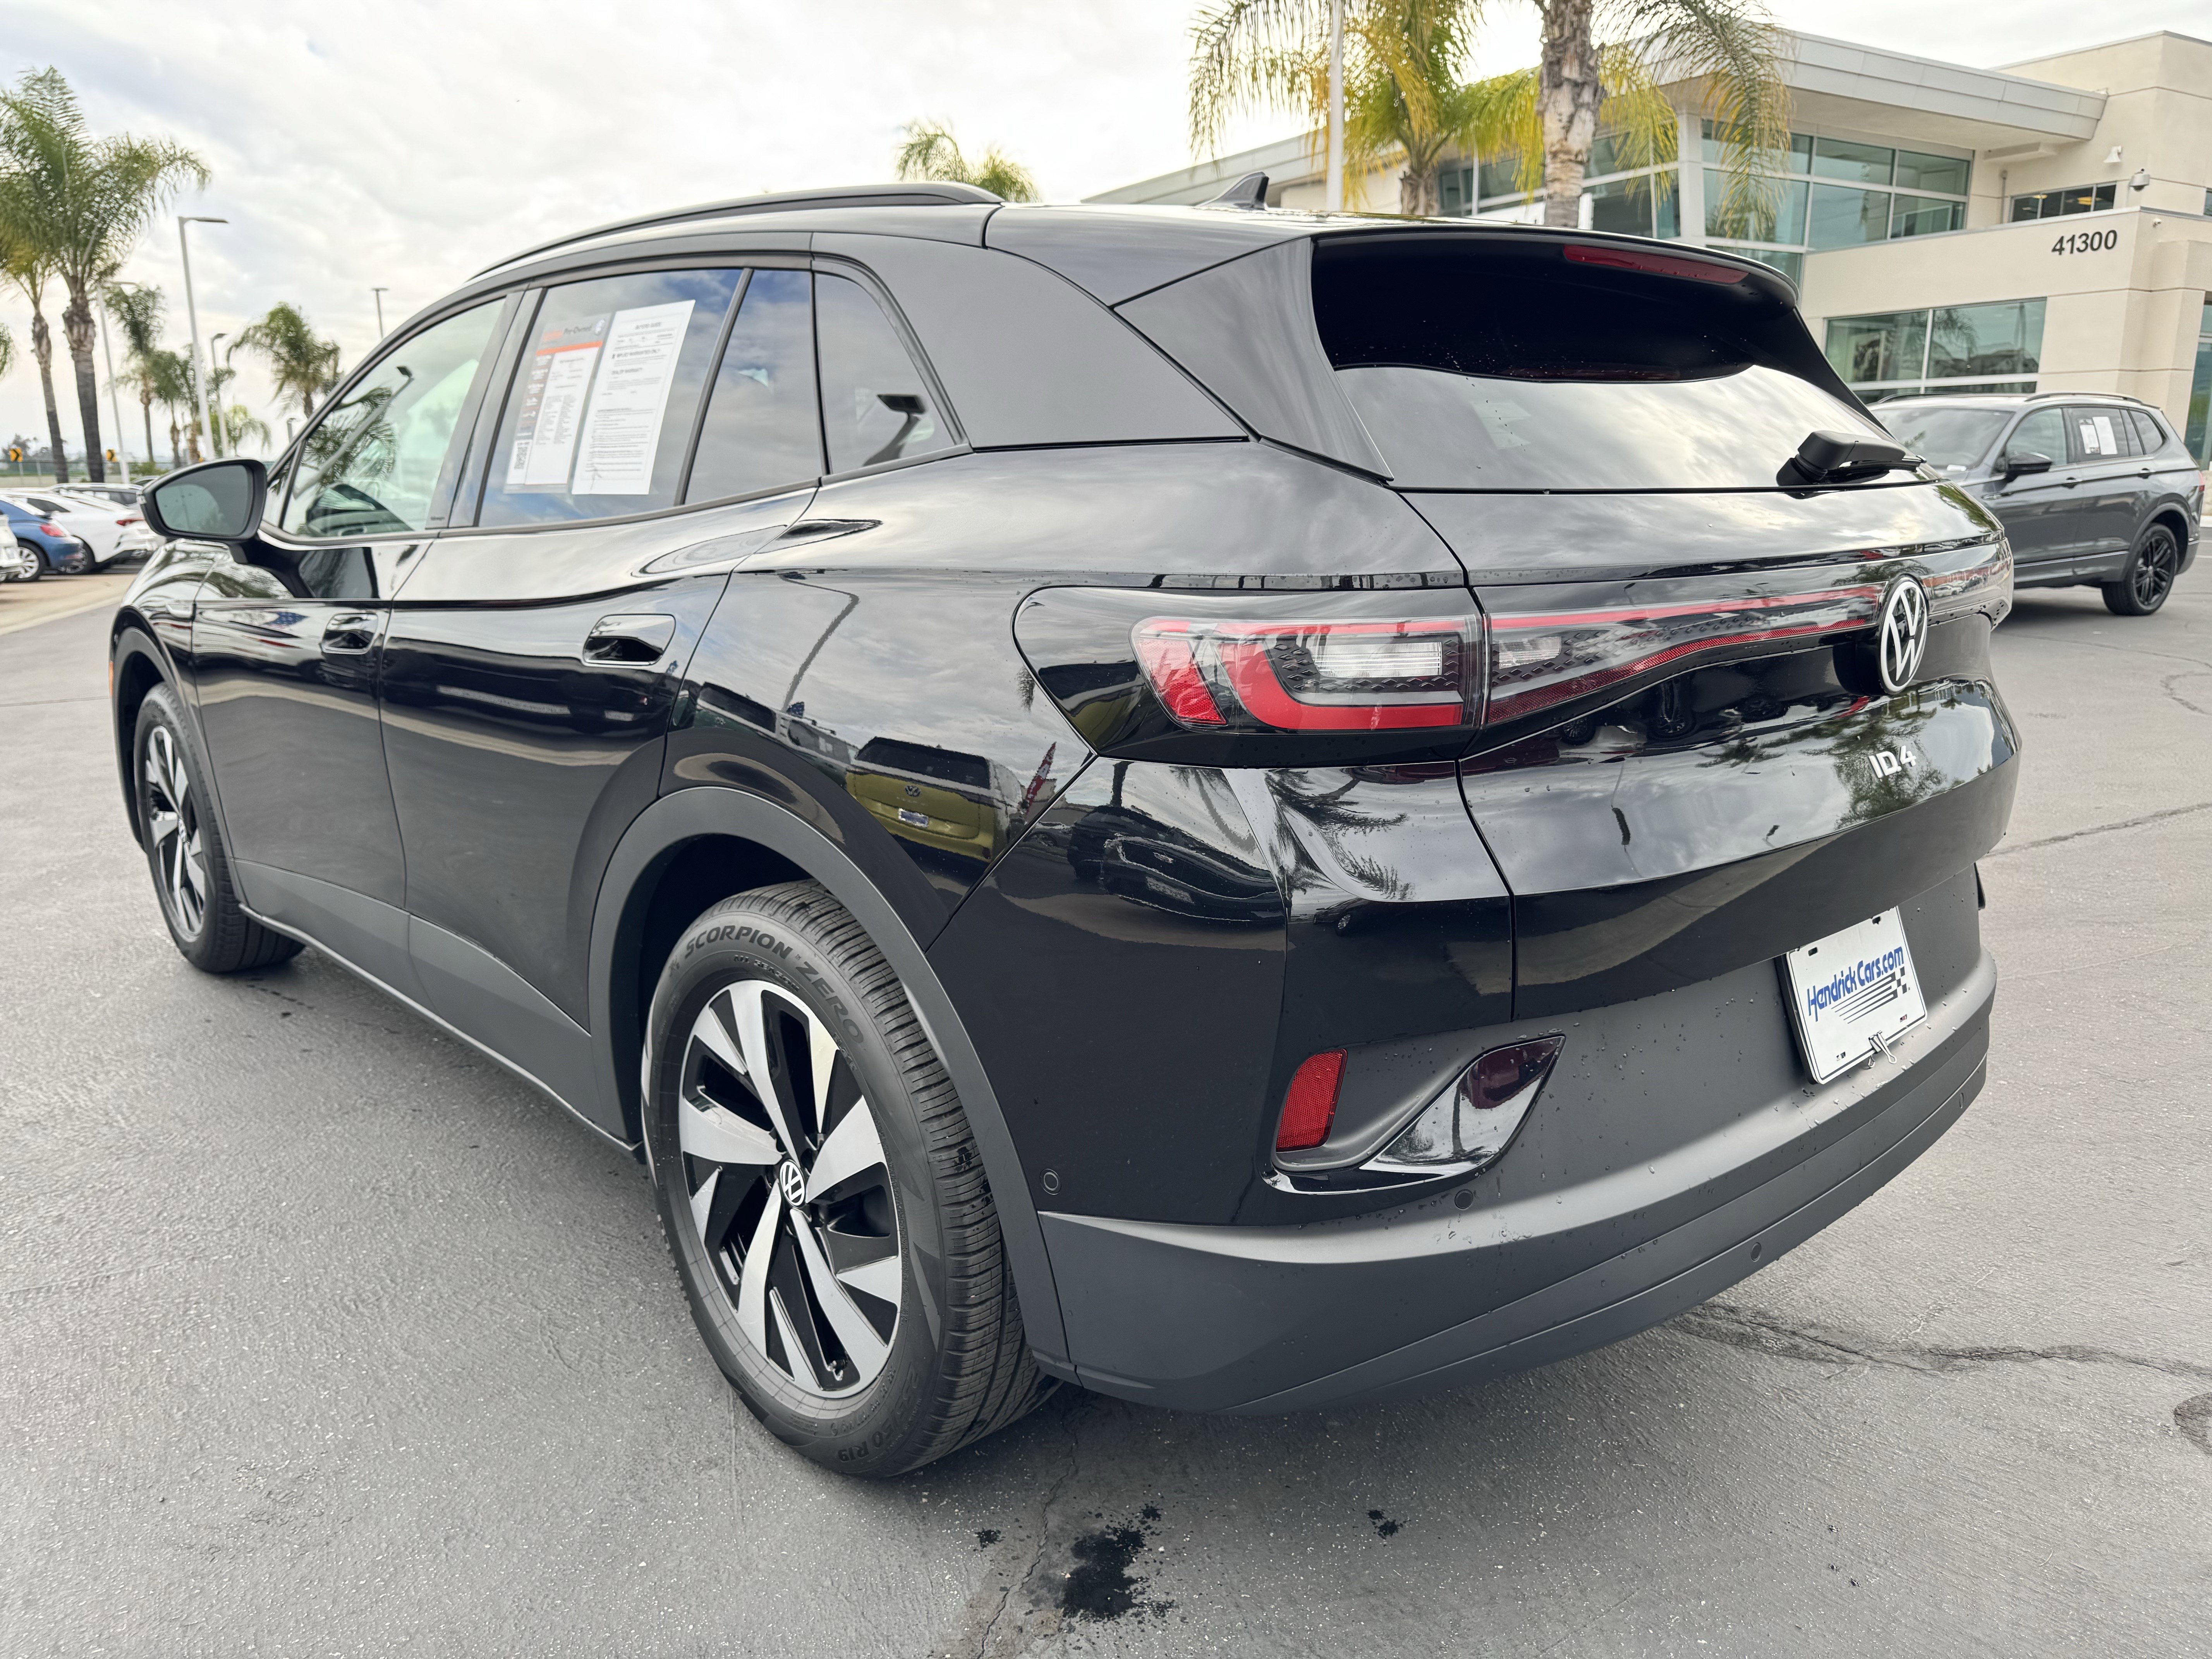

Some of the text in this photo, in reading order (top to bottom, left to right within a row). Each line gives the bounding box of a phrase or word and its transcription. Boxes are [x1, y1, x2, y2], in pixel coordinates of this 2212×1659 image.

[2051, 230, 2117, 255] 41300
[1880, 581, 1927, 692] VW
[1869, 745, 1917, 778] ID.4
[685, 925, 793, 959] SCORPION
[795, 961, 864, 1044] ZERO
[733, 954, 800, 992] ALL SEASON
[780, 1161, 805, 1206] VW
[837, 1441, 870, 1463] R19
